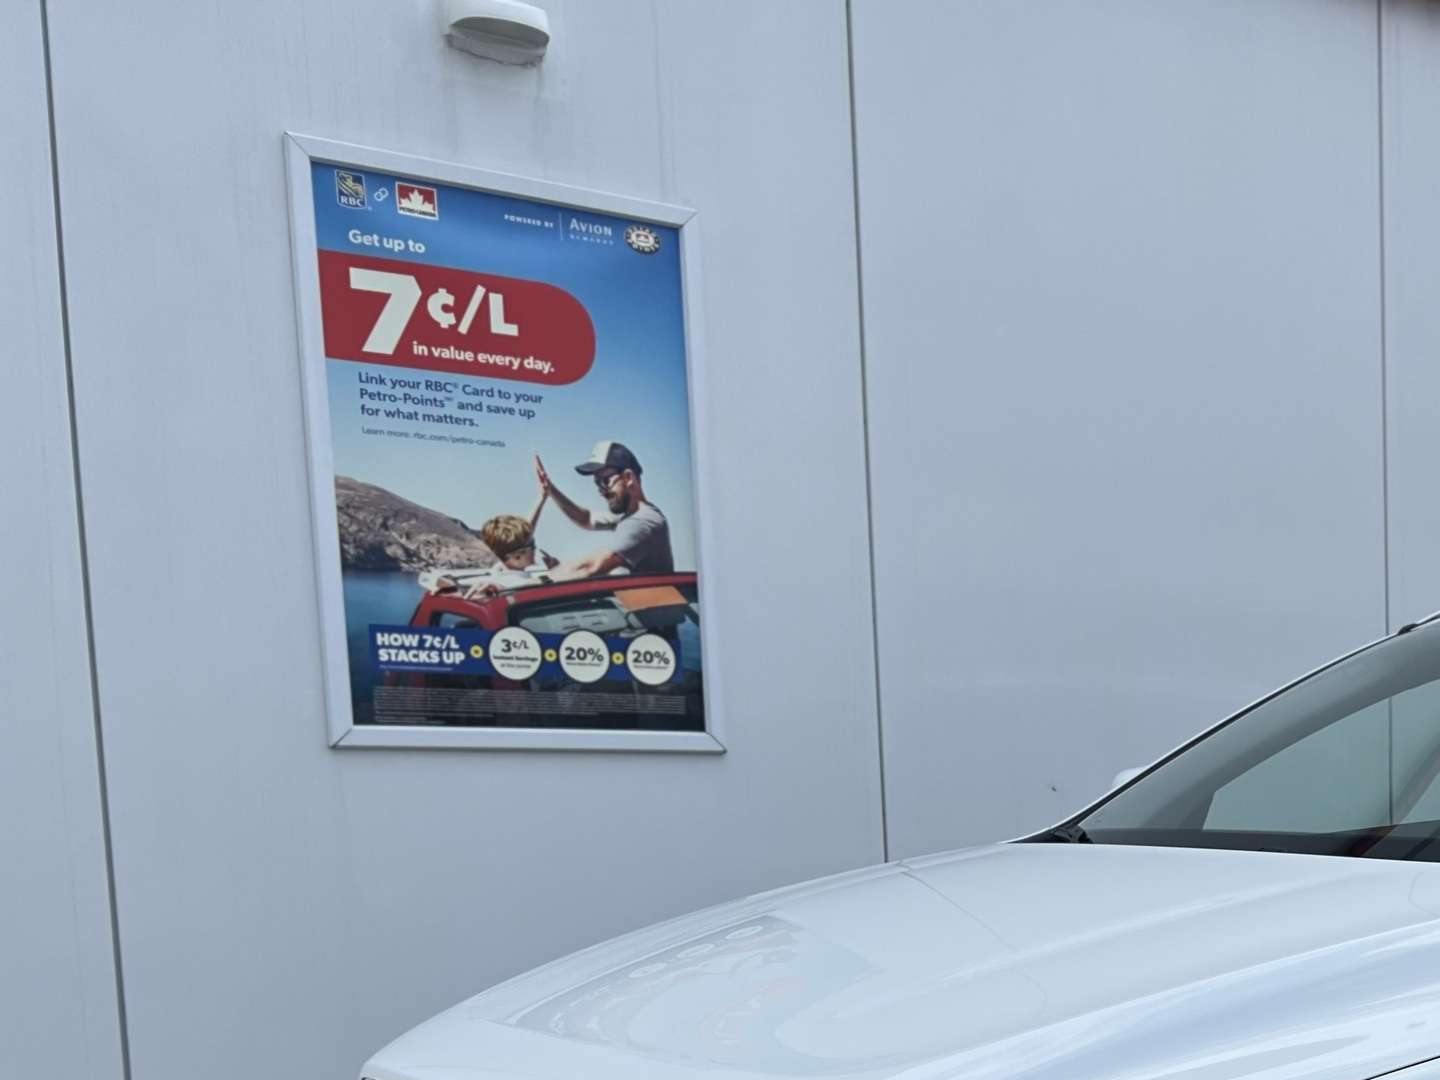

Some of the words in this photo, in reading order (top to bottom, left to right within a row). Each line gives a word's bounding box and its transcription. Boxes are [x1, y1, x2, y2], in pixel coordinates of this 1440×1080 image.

[348, 229, 380, 247] Get
[383, 238, 405, 252] up
[408, 239, 426, 253] to
[413, 341, 429, 357] in
[431, 345, 475, 362] value
[477, 352, 521, 369] every
[524, 356, 555, 373] day.
[358, 371, 388, 386] Link
[390, 377, 422, 390] your
[462, 384, 495, 398] Card
[497, 389, 511, 400] to
[514, 393, 544, 405] your
[360, 404, 381, 417] for
[384, 407, 419, 421] what
[422, 412, 480, 428] matters.
[457, 400, 483, 412] and
[486, 403, 516, 416] save
[519, 408, 536, 420] up
[361, 426, 385, 436] Learn
[376, 632, 420, 647] HOW
[378, 648, 441, 663] STACKS
[442, 651, 466, 665] UP
[564, 646, 605, 663] 20%
[631, 650, 671, 665] 20%
